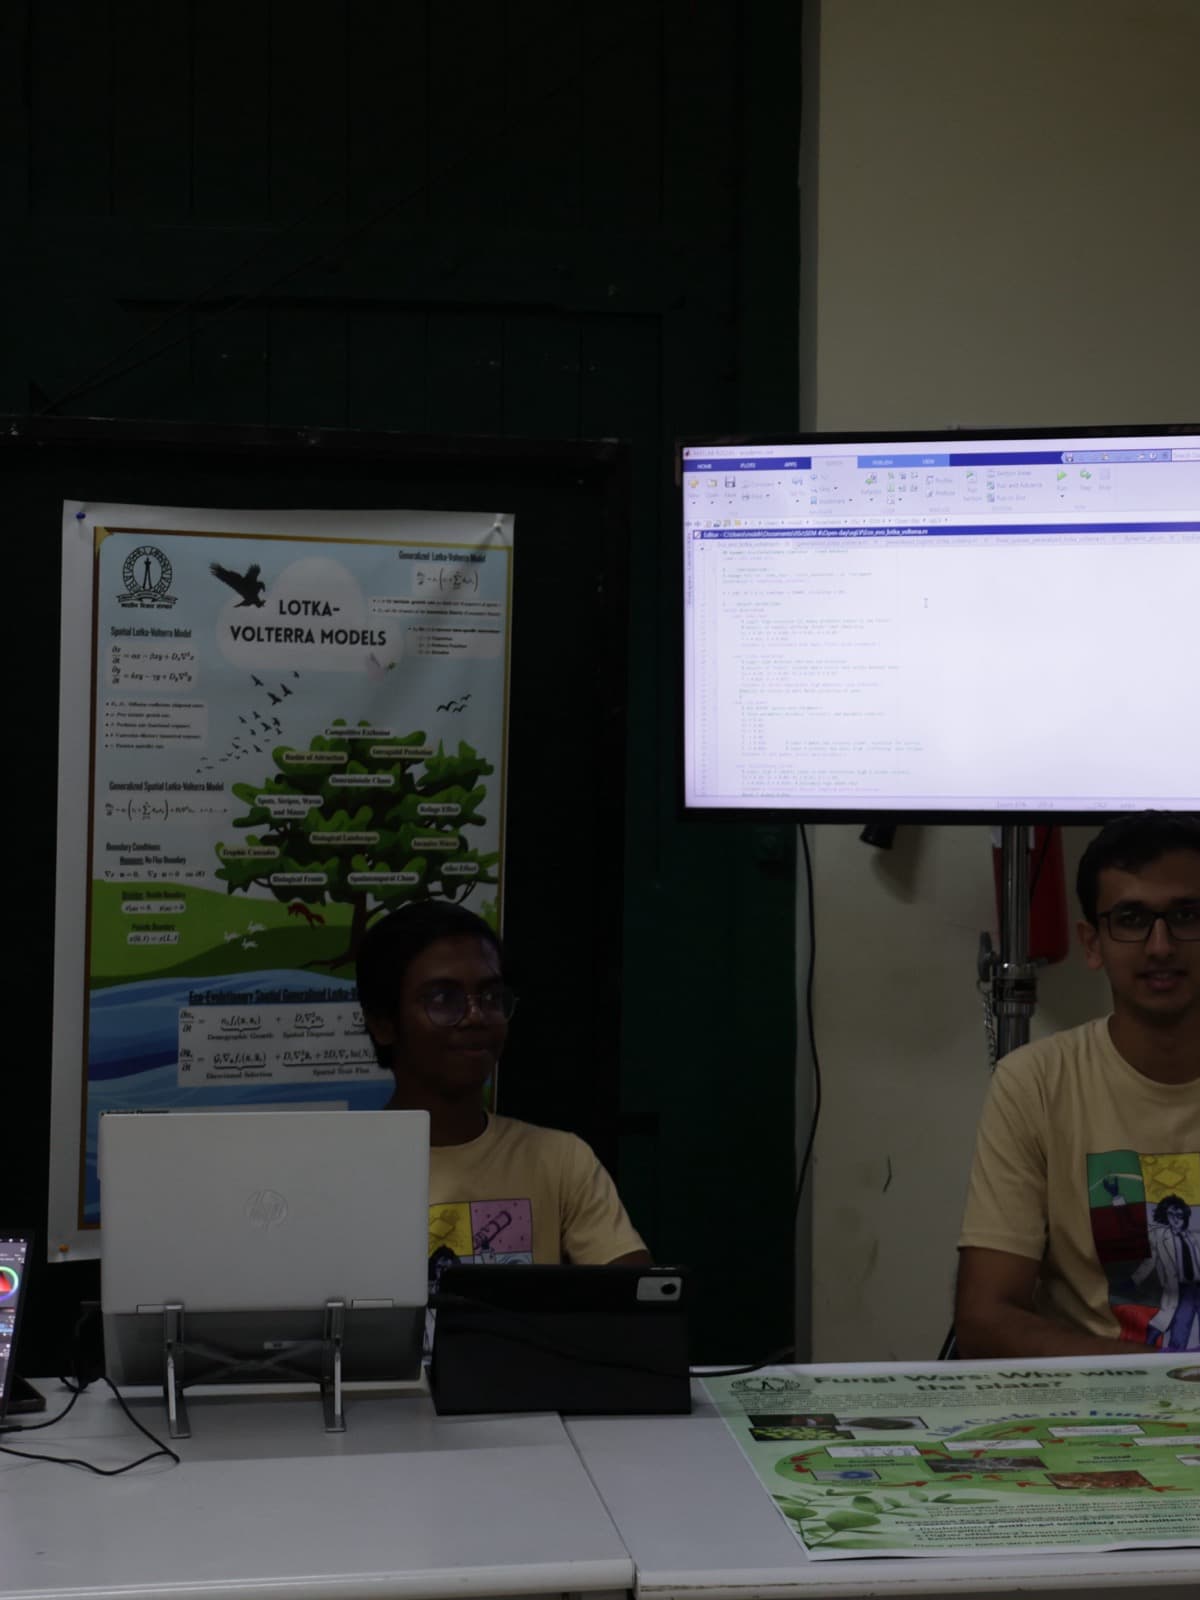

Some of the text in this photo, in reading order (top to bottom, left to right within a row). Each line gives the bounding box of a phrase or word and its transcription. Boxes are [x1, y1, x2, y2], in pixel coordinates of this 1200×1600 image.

[279, 600, 340, 616] LOTKA-
[111, 626, 192, 638] Spatial Lotka-Volterra Model
[231, 625, 314, 644] VOLTERRA
[321, 628, 386, 646] MODELS
[109, 781, 224, 793] Generalized Spatial Lotka-Volterra Model
[814, 1374, 895, 1385] Fungi
[998, 1370, 1072, 1379] Who
[1080, 1368, 1148, 1377] wins
[917, 1380, 1062, 1391] the plate?
